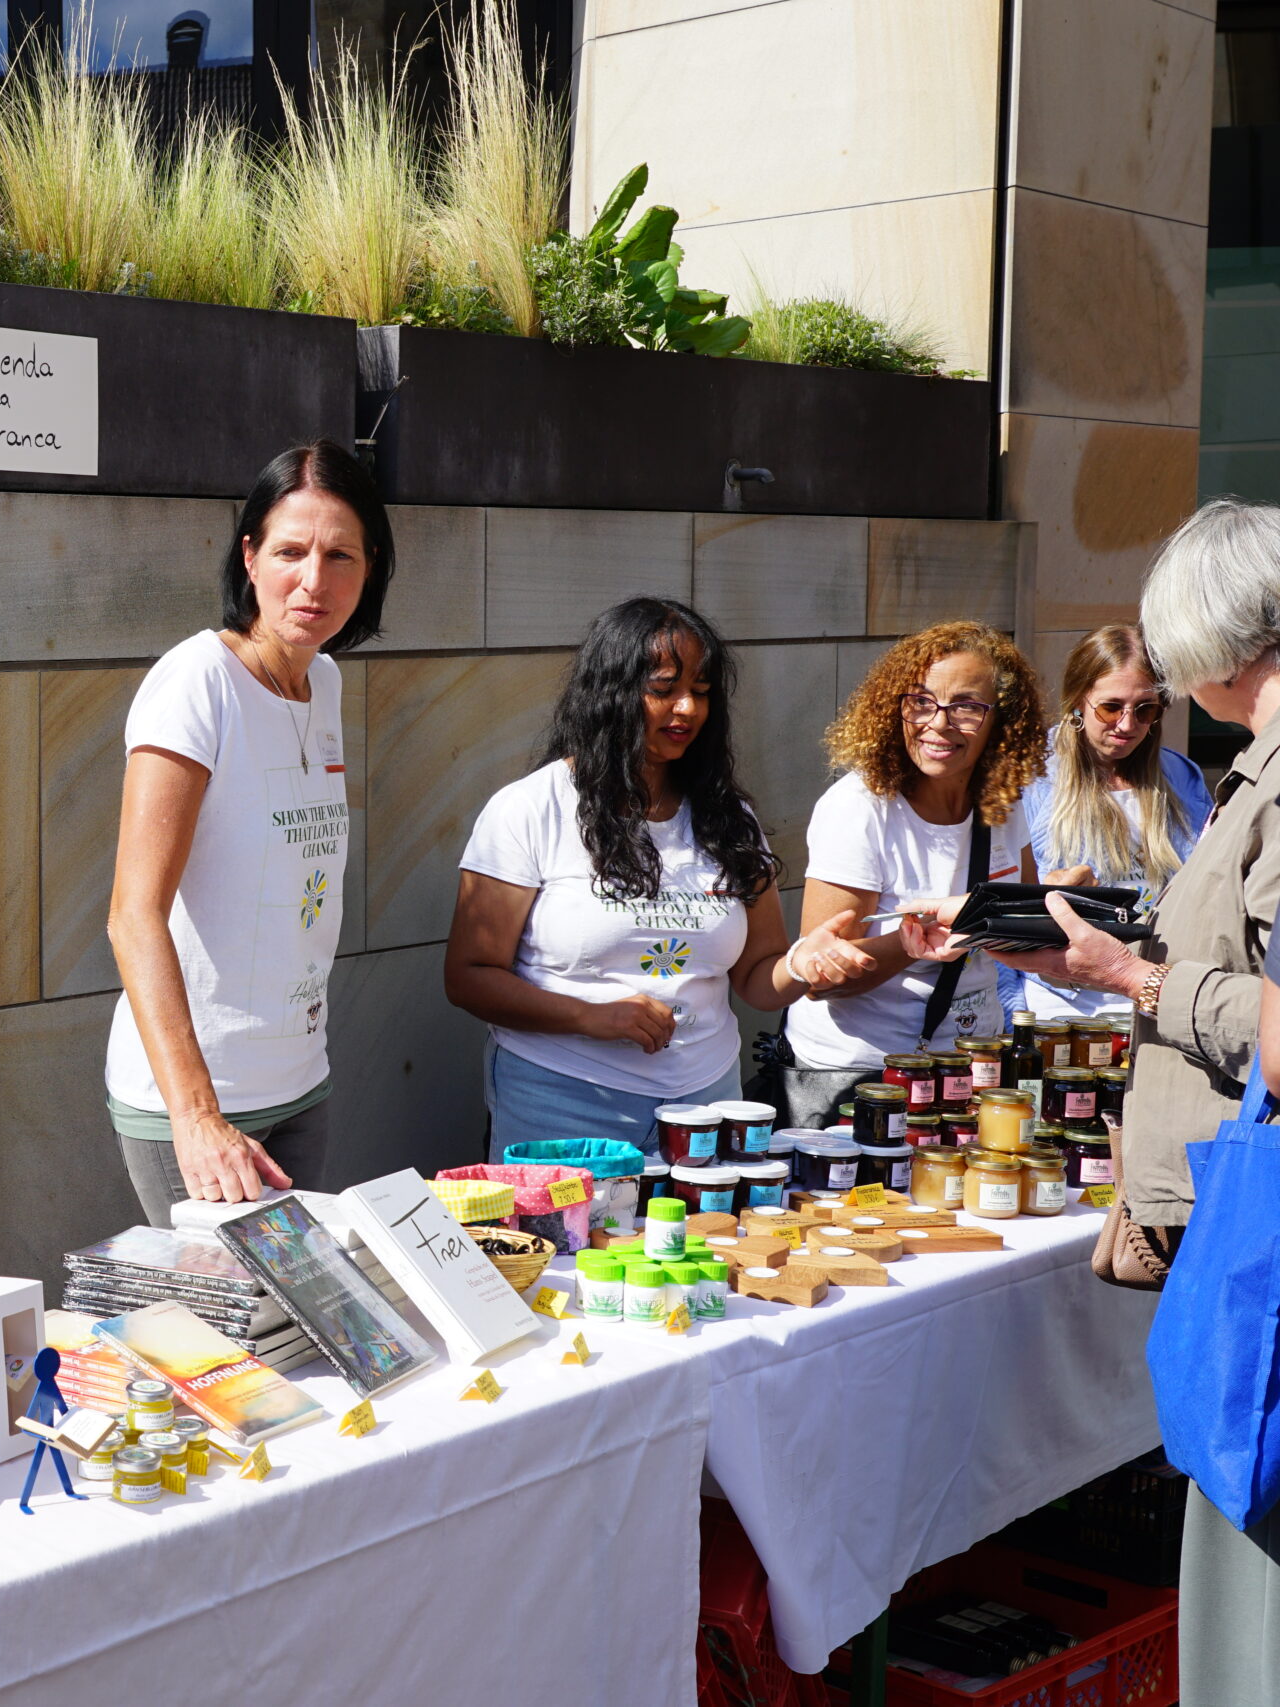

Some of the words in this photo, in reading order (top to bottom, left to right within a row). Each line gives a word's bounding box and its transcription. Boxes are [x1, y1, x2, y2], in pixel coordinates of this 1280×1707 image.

[272, 808, 308, 826] SHOW
[308, 806, 327, 822] THE
[284, 826, 313, 844] THAT
[313, 822, 336, 840] LOVE
[336, 820, 348, 836] CA
[302, 840, 339, 859] CHANGE
[652, 901, 694, 916] LOVE
[697, 904, 731, 917] CAN
[634, 915, 705, 930] CHANGE
[390, 1196, 471, 1269] Frei
[186, 1359, 261, 1391] HOFFNUNG
